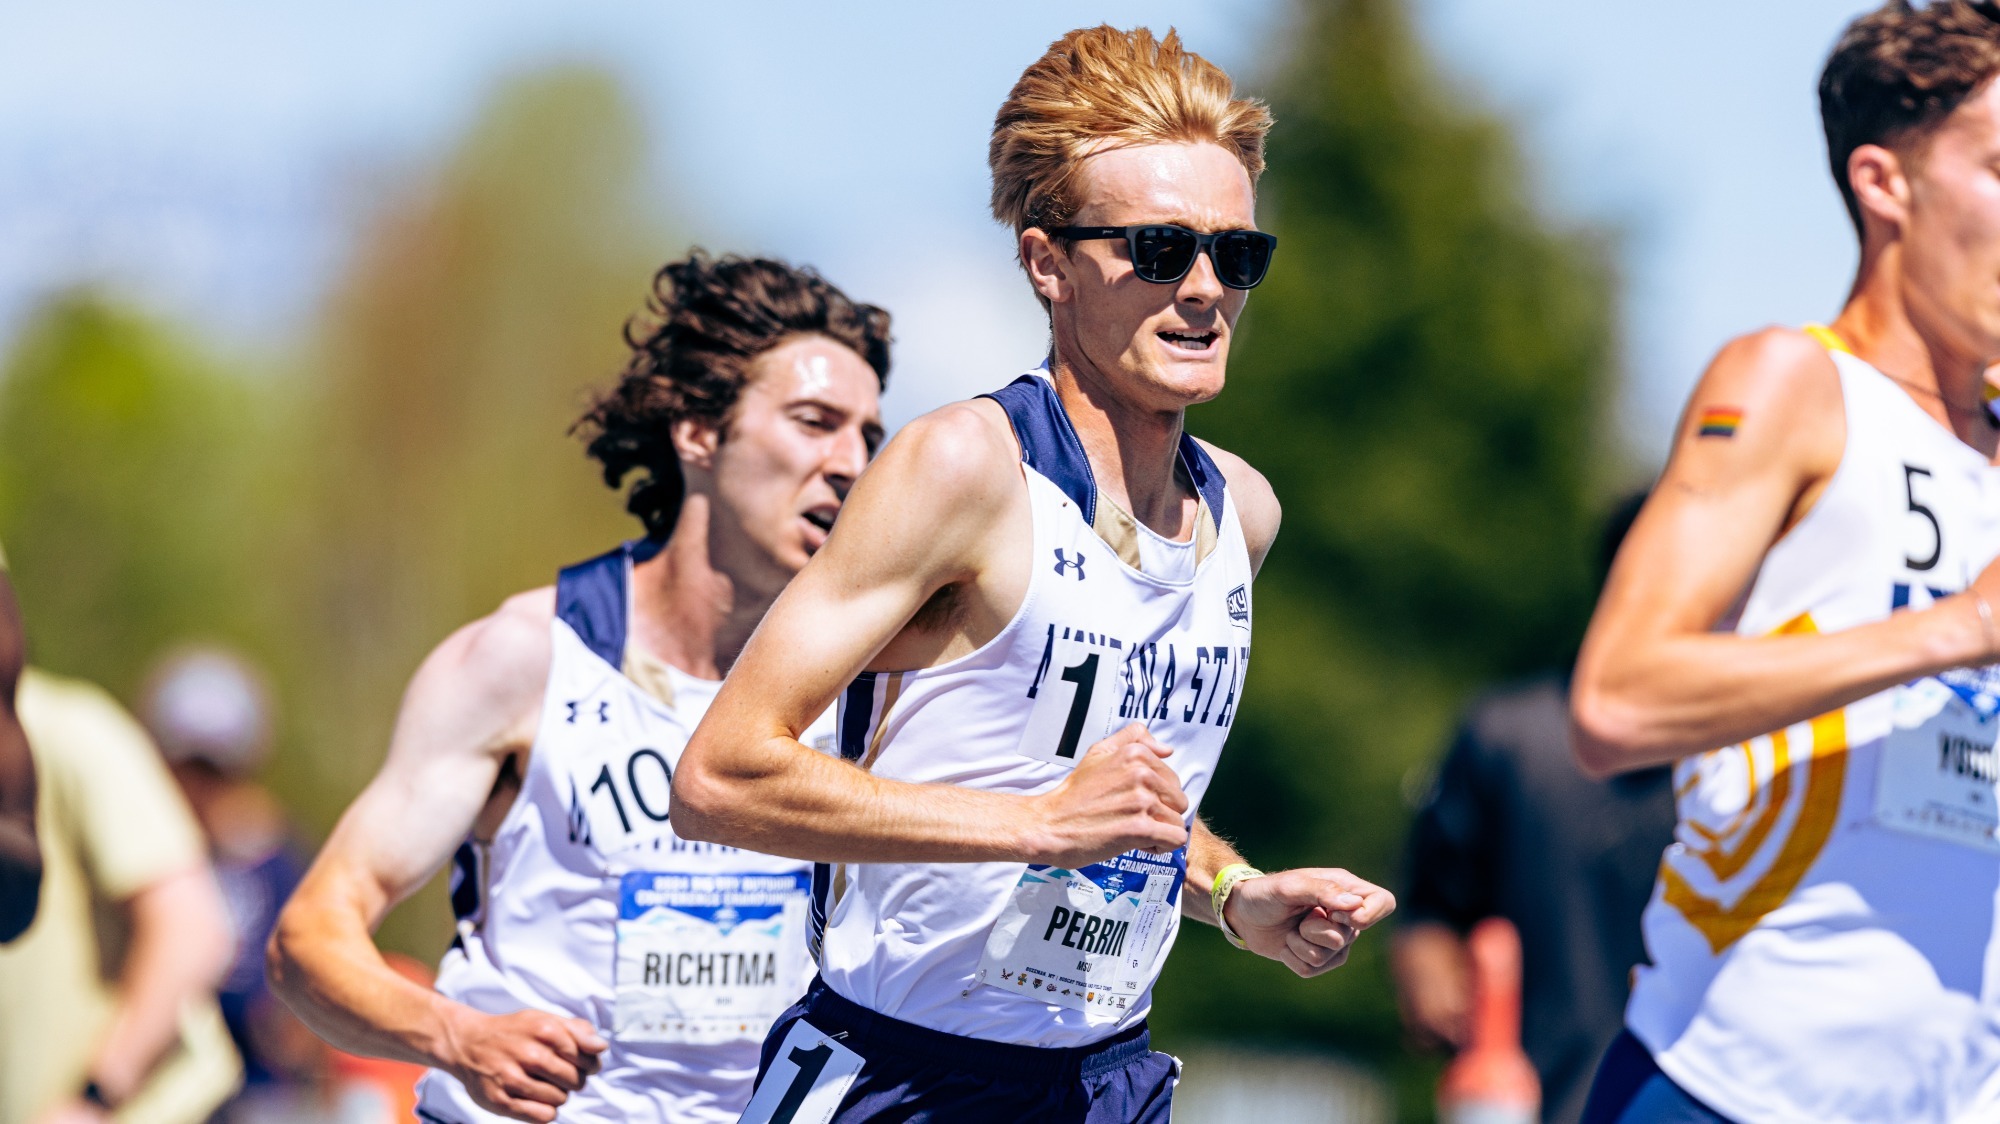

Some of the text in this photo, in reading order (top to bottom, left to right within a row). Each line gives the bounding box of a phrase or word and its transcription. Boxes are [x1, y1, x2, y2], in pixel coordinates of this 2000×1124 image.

[1904, 464, 1941, 571] 5
[1228, 587, 1247, 614] SKY
[1055, 652, 1100, 760] 1
[591, 750, 672, 833] 10
[1043, 906, 1129, 957] PERRIN
[643, 953, 776, 985] RICHTMA
[1076, 960, 1093, 973] MSU
[768, 1044, 834, 1124] 1
